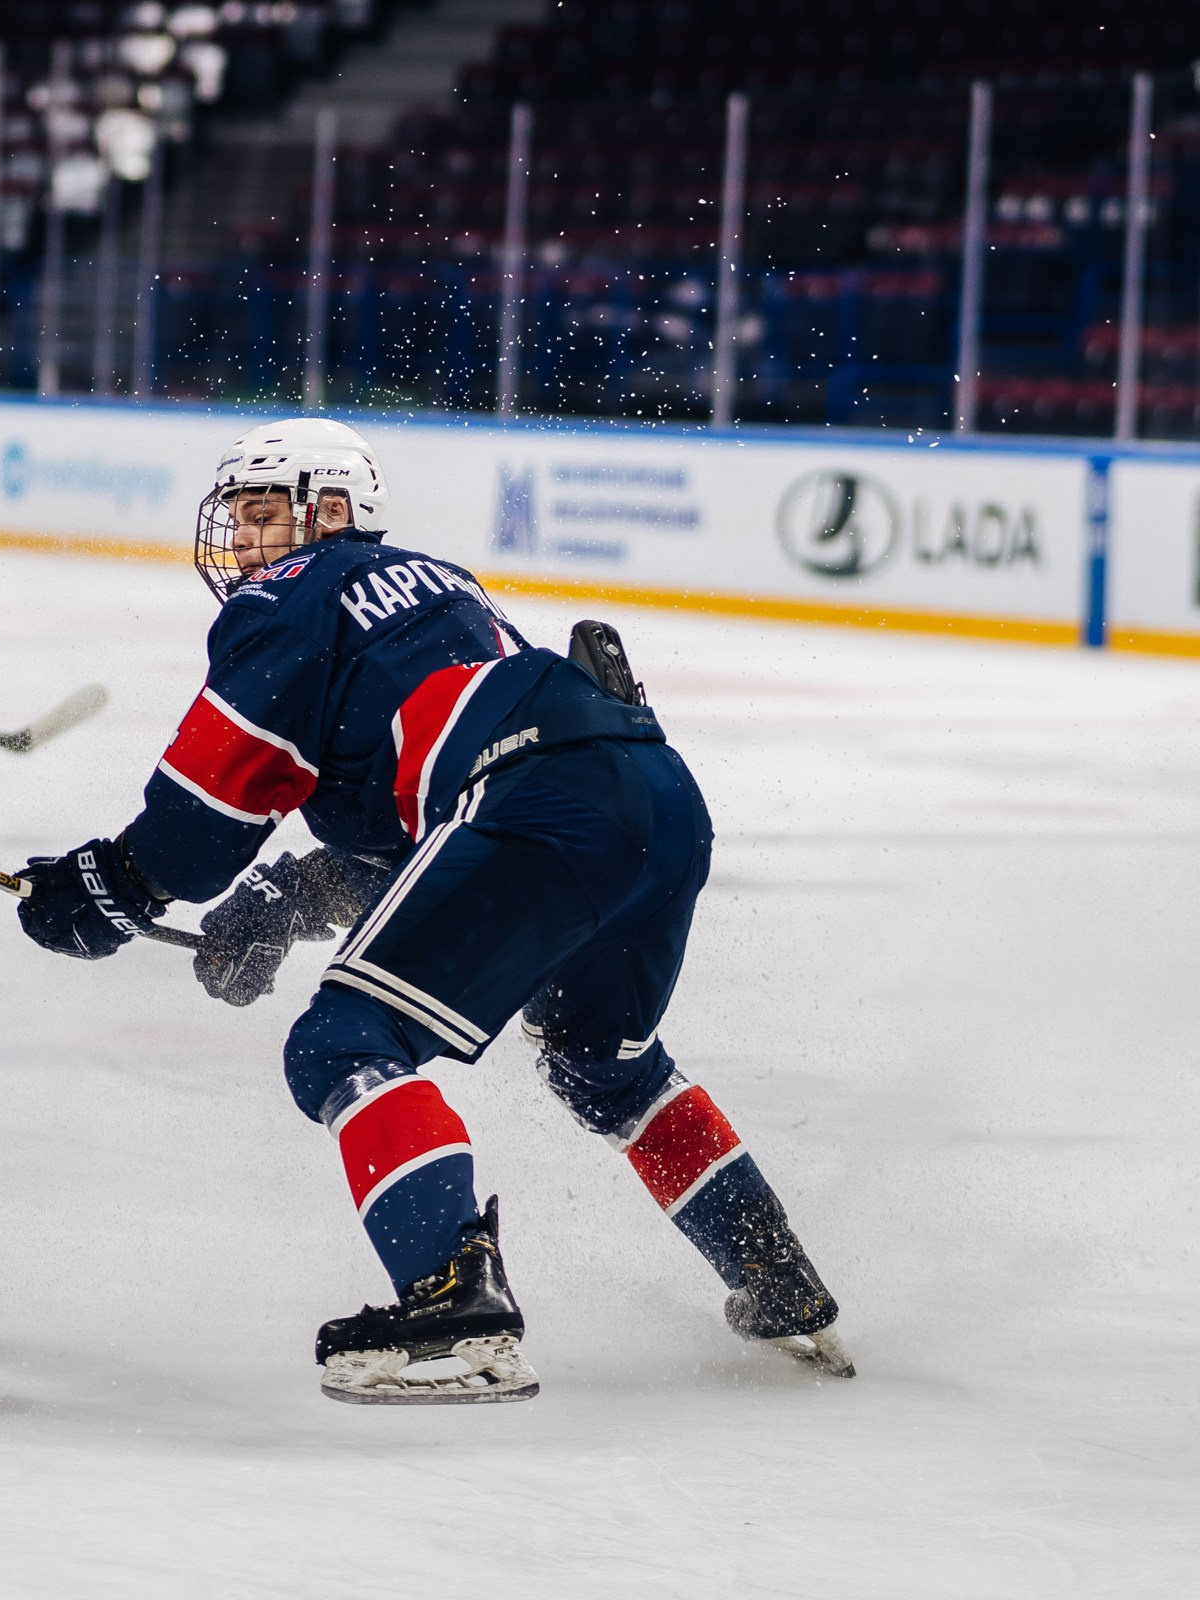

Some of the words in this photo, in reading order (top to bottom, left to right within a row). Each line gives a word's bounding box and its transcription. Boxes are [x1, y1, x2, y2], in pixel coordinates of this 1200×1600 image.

[313, 468, 350, 477] CCM
[912, 499, 1042, 565] LADA
[340, 560, 509, 632] КАРГА
[77, 850, 147, 939] BAUER
